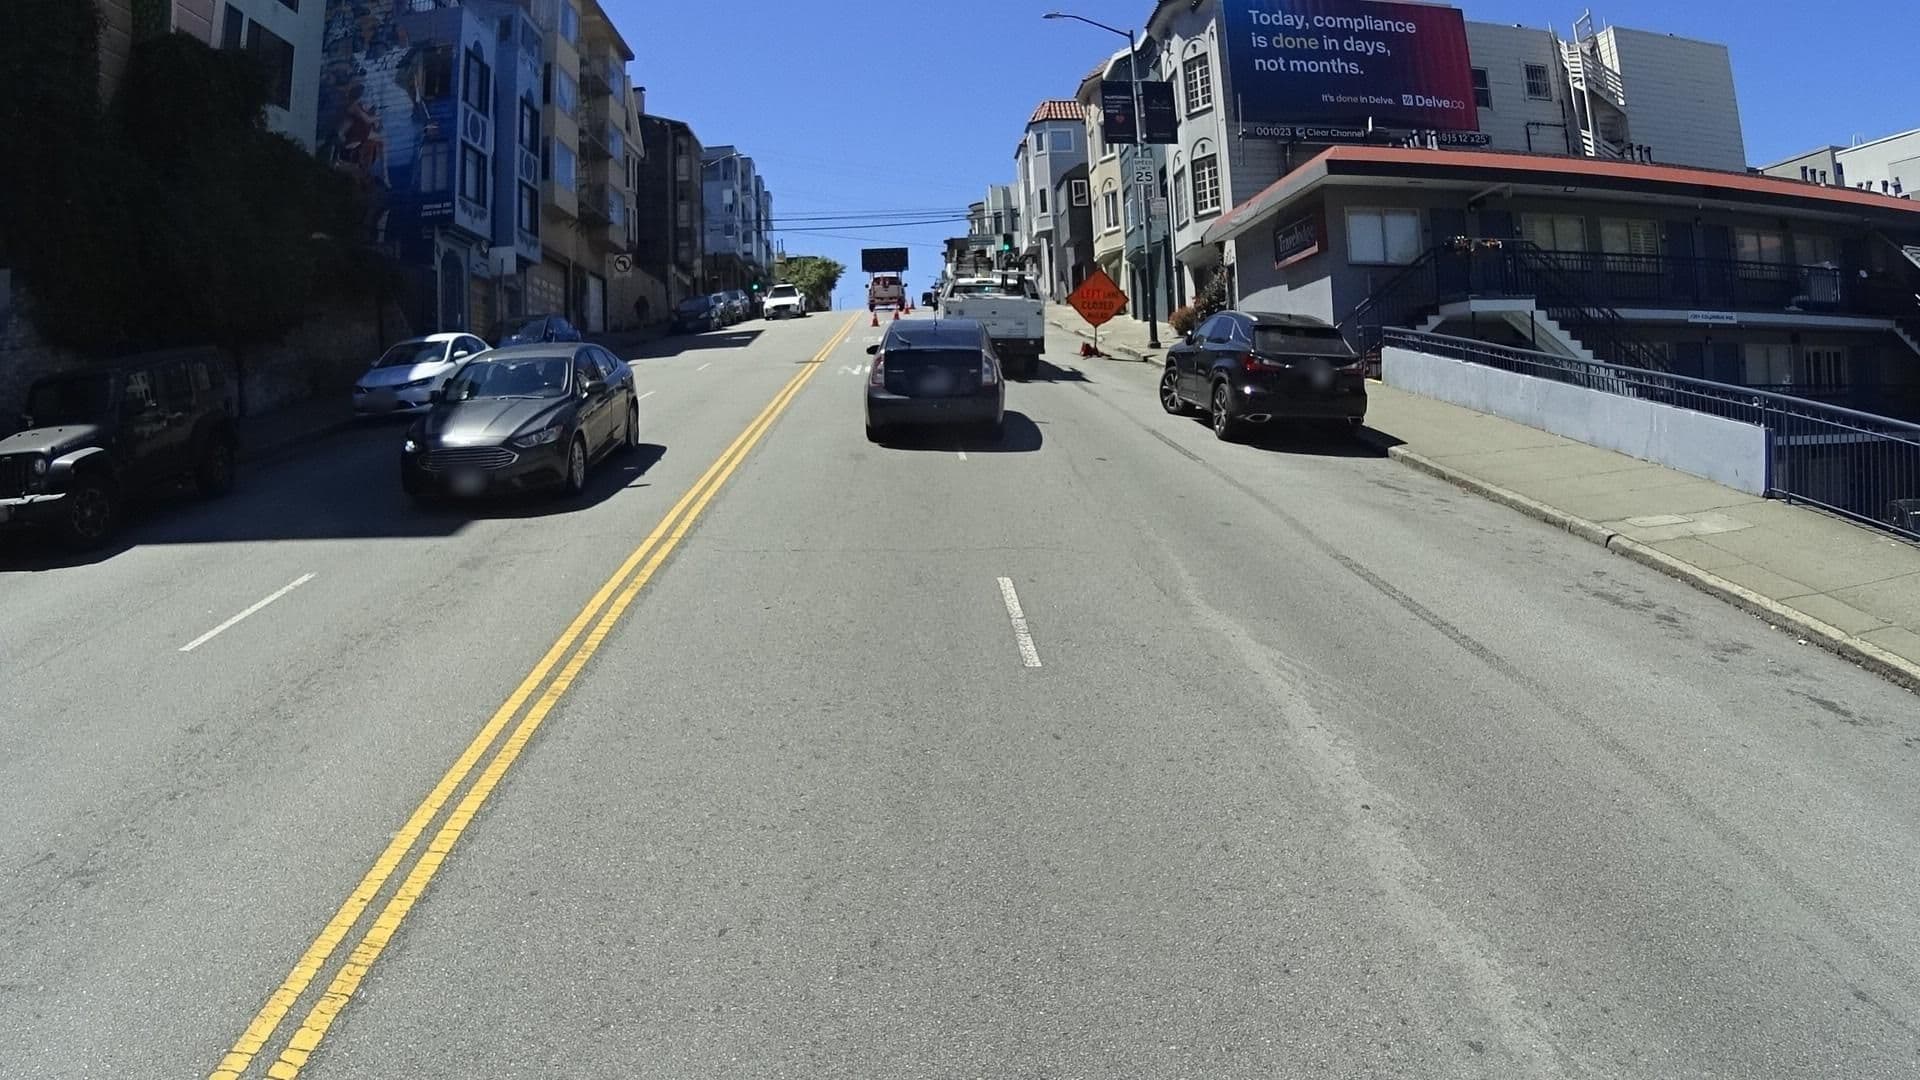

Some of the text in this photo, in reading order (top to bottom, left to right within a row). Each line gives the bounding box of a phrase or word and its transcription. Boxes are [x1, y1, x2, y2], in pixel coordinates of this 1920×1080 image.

[1248, 10, 1416, 34] Today, compliance
[1251, 32, 1391, 57] is done in days,
[1254, 57, 1364, 75] not months.
[1336, 94, 1359, 104] done
[1360, 95, 1368, 104] in
[1368, 95, 1396, 105] Delve.
[1415, 95, 1465, 110] Delve.co
[1256, 126, 1291, 137] 001023
[1306, 127, 1365, 138] Clear Channel
[1135, 171, 1153, 182] 25
[1080, 288, 1102, 298] LEFT
[1081, 300, 1114, 310] CLOSED
